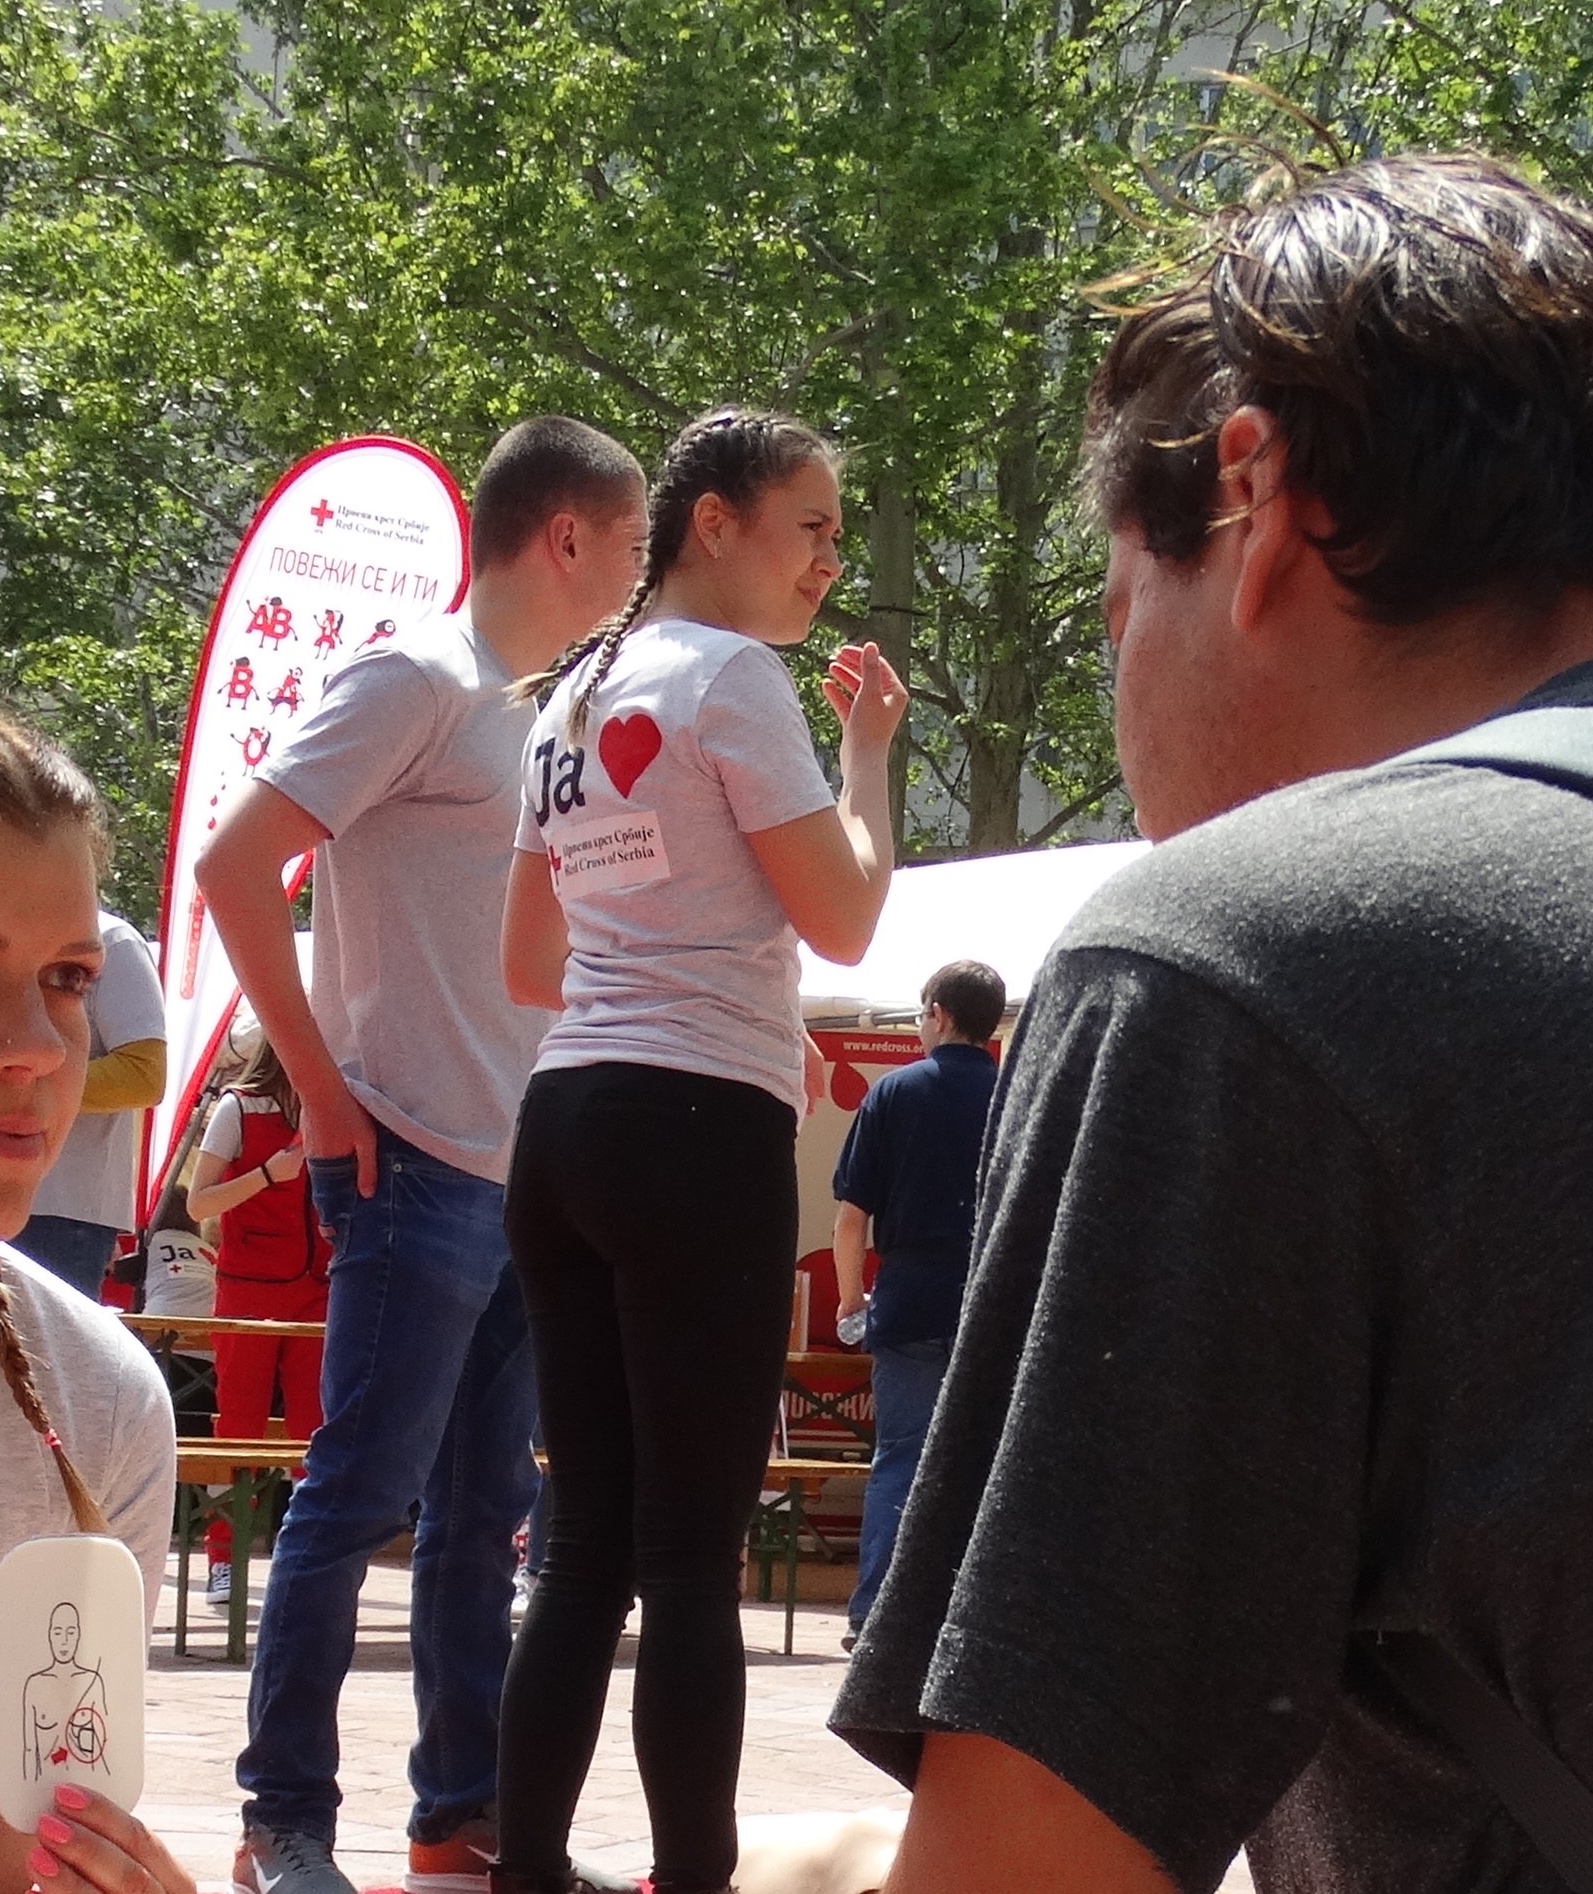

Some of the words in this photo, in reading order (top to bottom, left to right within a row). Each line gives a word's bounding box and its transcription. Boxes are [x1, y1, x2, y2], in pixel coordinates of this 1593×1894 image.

[335, 519, 353, 531] Red
[355, 522, 381, 537] Cross
[383, 529, 393, 539] of
[394, 531, 424, 545] Serbia
[270, 547, 357, 586] ПОВЕЖИ
[361, 565, 388, 592] СЕ
[391, 571, 407, 597] И
[413, 574, 438, 602] ТИ
[534, 737, 586, 828] Ja
[615, 825, 655, 847] Србије
[618, 845, 656, 863] Serbia
[843, 1041, 926, 1053] www.redcross.or
[160, 1244, 197, 1263] Ja
